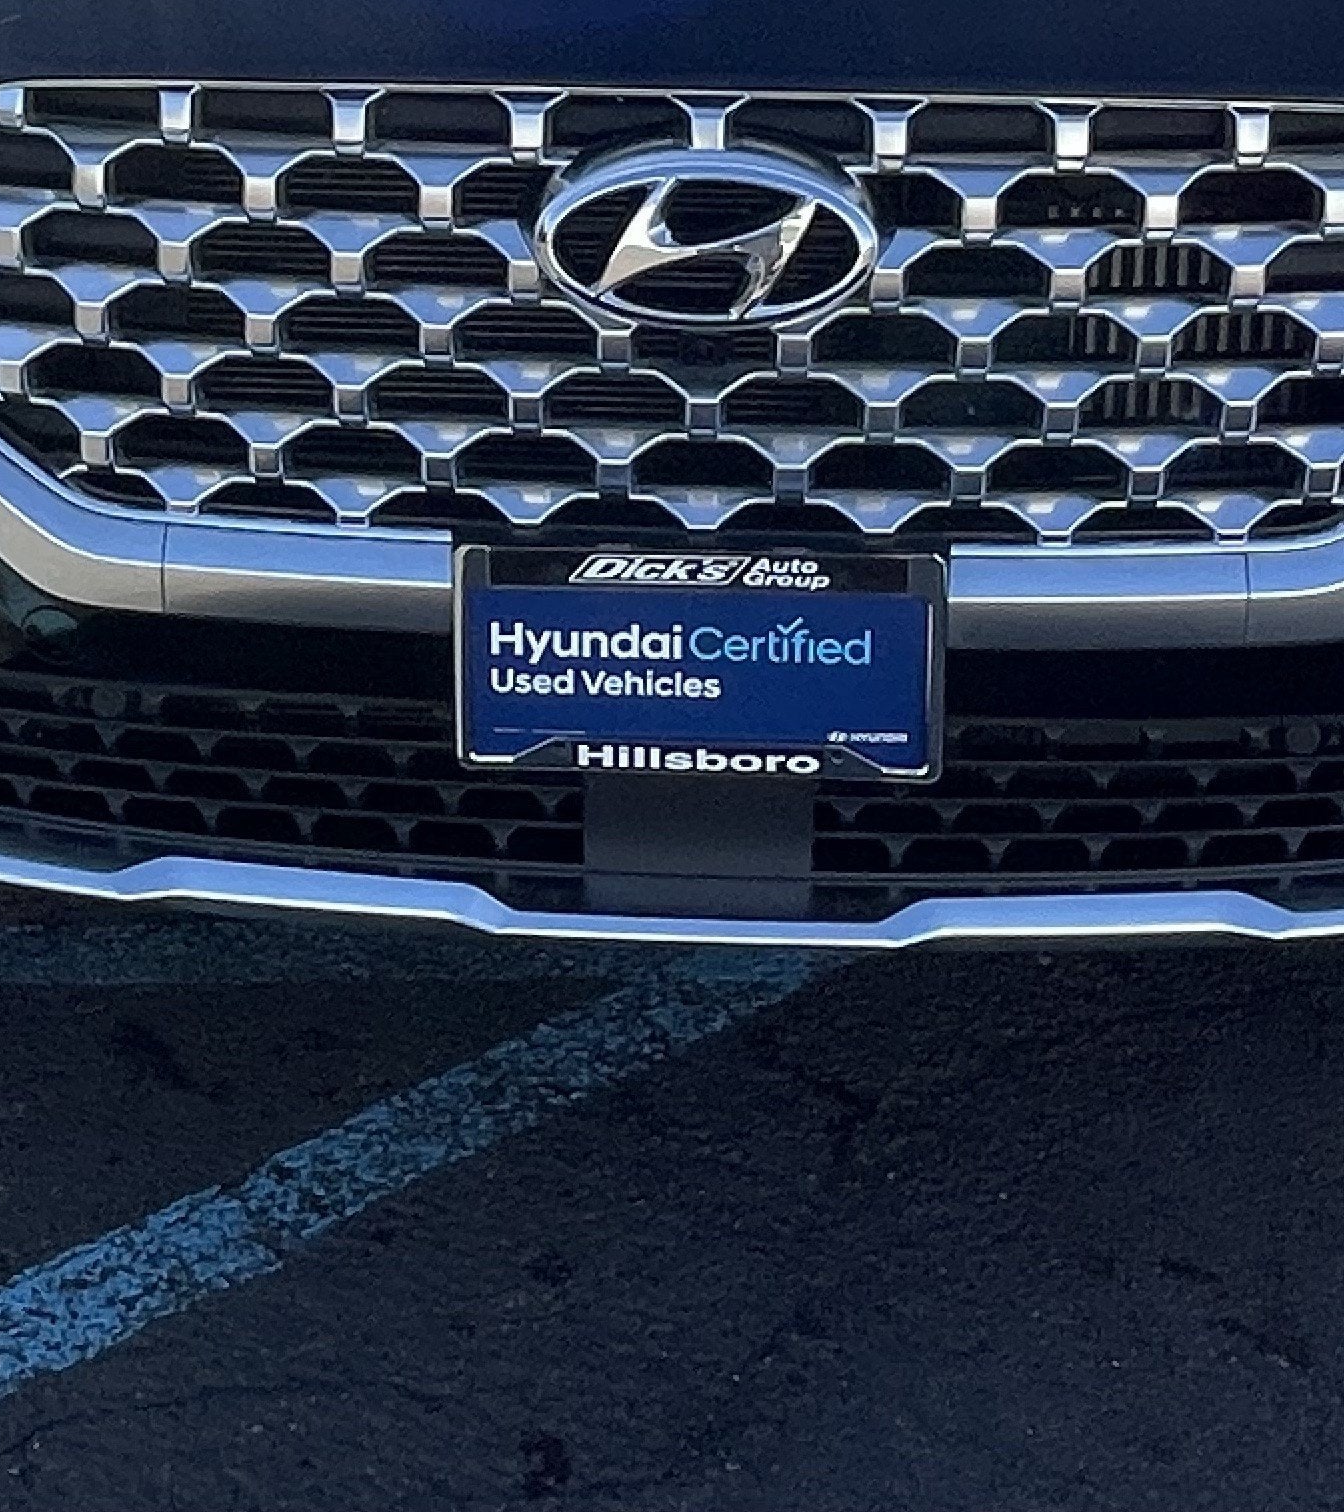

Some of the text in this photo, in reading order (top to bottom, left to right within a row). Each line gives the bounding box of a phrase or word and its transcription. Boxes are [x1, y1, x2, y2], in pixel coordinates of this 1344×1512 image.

[751, 558, 819, 574] Auto
[742, 574, 831, 591] Group
[490, 618, 872, 665] Hyundai Certified
[490, 668, 722, 698] Used Vehicles
[577, 745, 820, 774] Hillsboro
